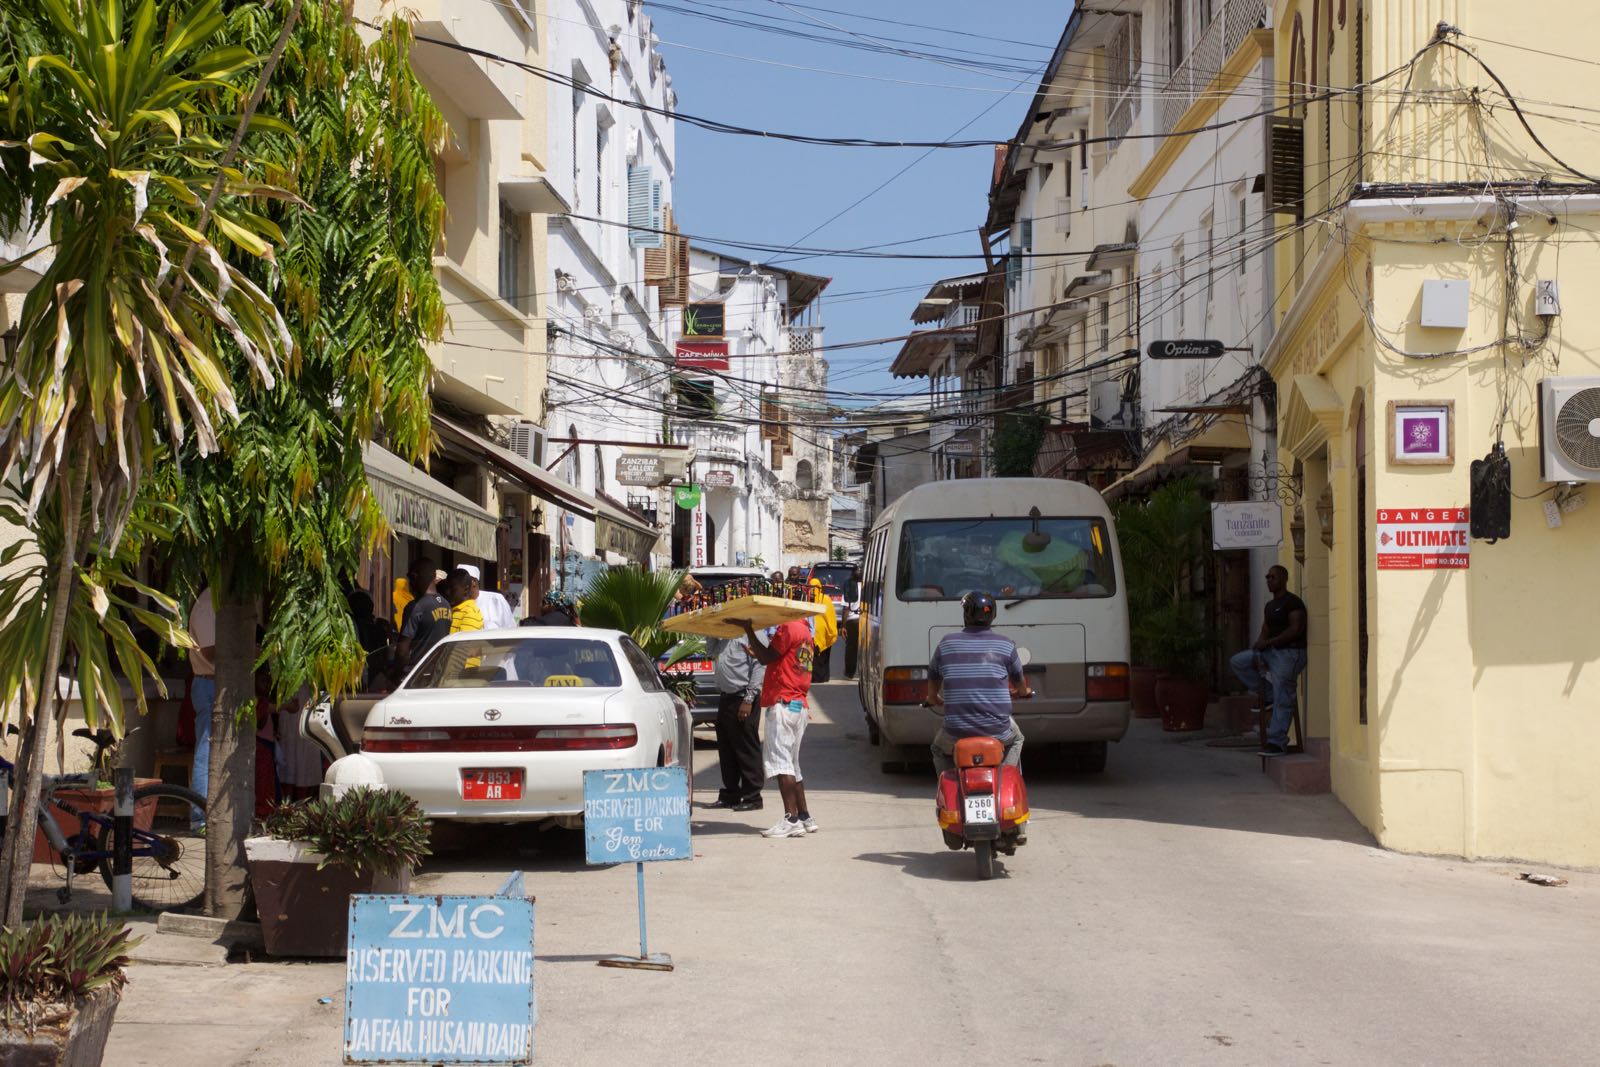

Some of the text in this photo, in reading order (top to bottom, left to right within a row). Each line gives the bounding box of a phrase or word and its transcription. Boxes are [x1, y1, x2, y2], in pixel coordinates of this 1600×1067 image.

[1544, 281, 1551, 290] 7
[1543, 296, 1554, 304] 10
[1164, 342, 1210, 356] Optima
[1225, 517, 1270, 530] Tanzanite
[1380, 511, 1465, 520] DANGER
[1395, 530, 1466, 546] ULTIMATE
[604, 771, 671, 793] ZMC
[486, 785, 502, 798] AR
[606, 826, 643, 852] Gem
[388, 904, 505, 939] ZMC
[347, 949, 532, 985] RISERVED PARKING
[407, 987, 451, 1017] FOR
[418, 1020, 485, 1056] HUSAIN
